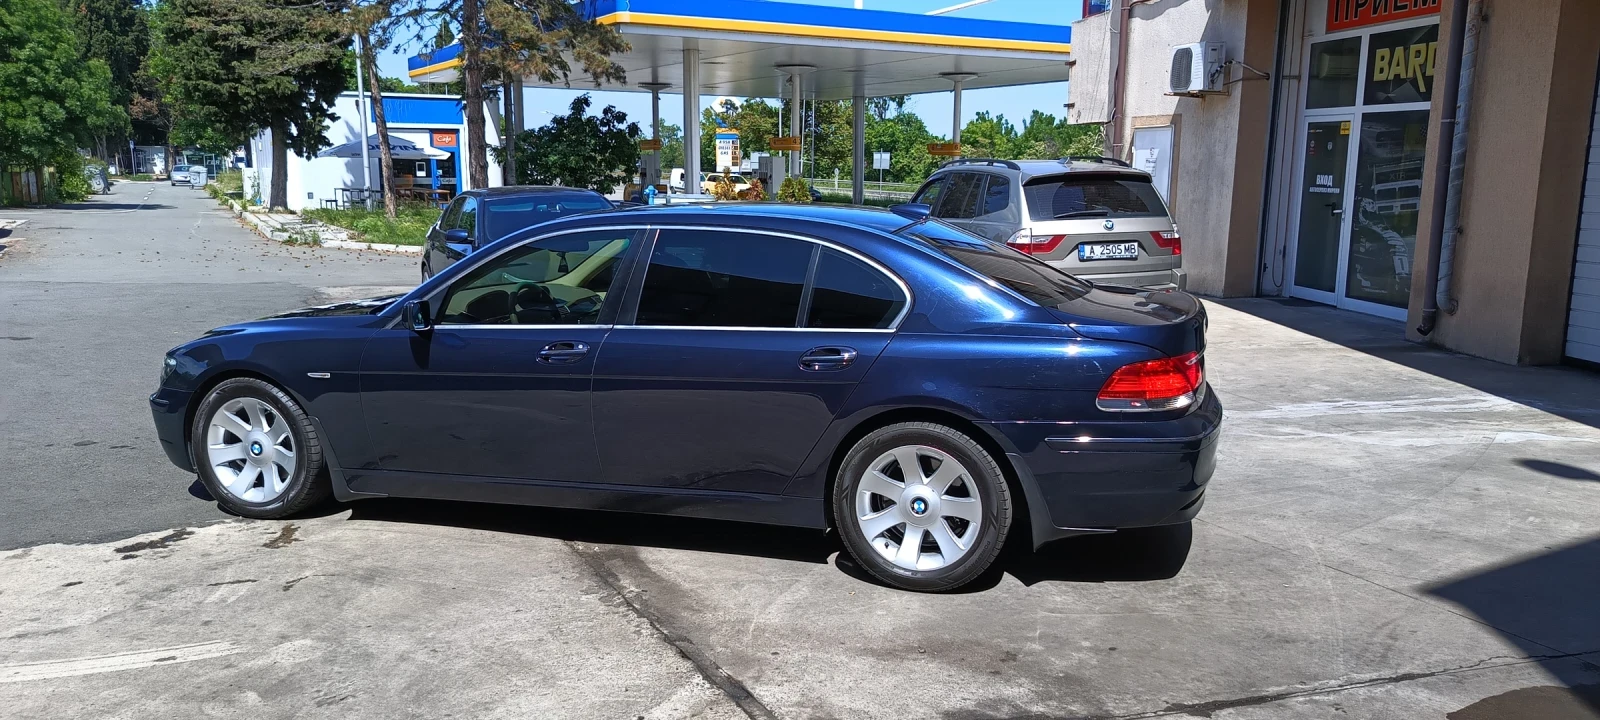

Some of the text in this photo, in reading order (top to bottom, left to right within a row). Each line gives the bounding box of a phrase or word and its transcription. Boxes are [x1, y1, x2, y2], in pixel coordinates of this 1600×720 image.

[1316, 174, 1333, 187] ВХОД
[1089, 246, 1096, 256] A
[1099, 245, 1123, 255] 2505
[1124, 244, 1137, 254] MB
